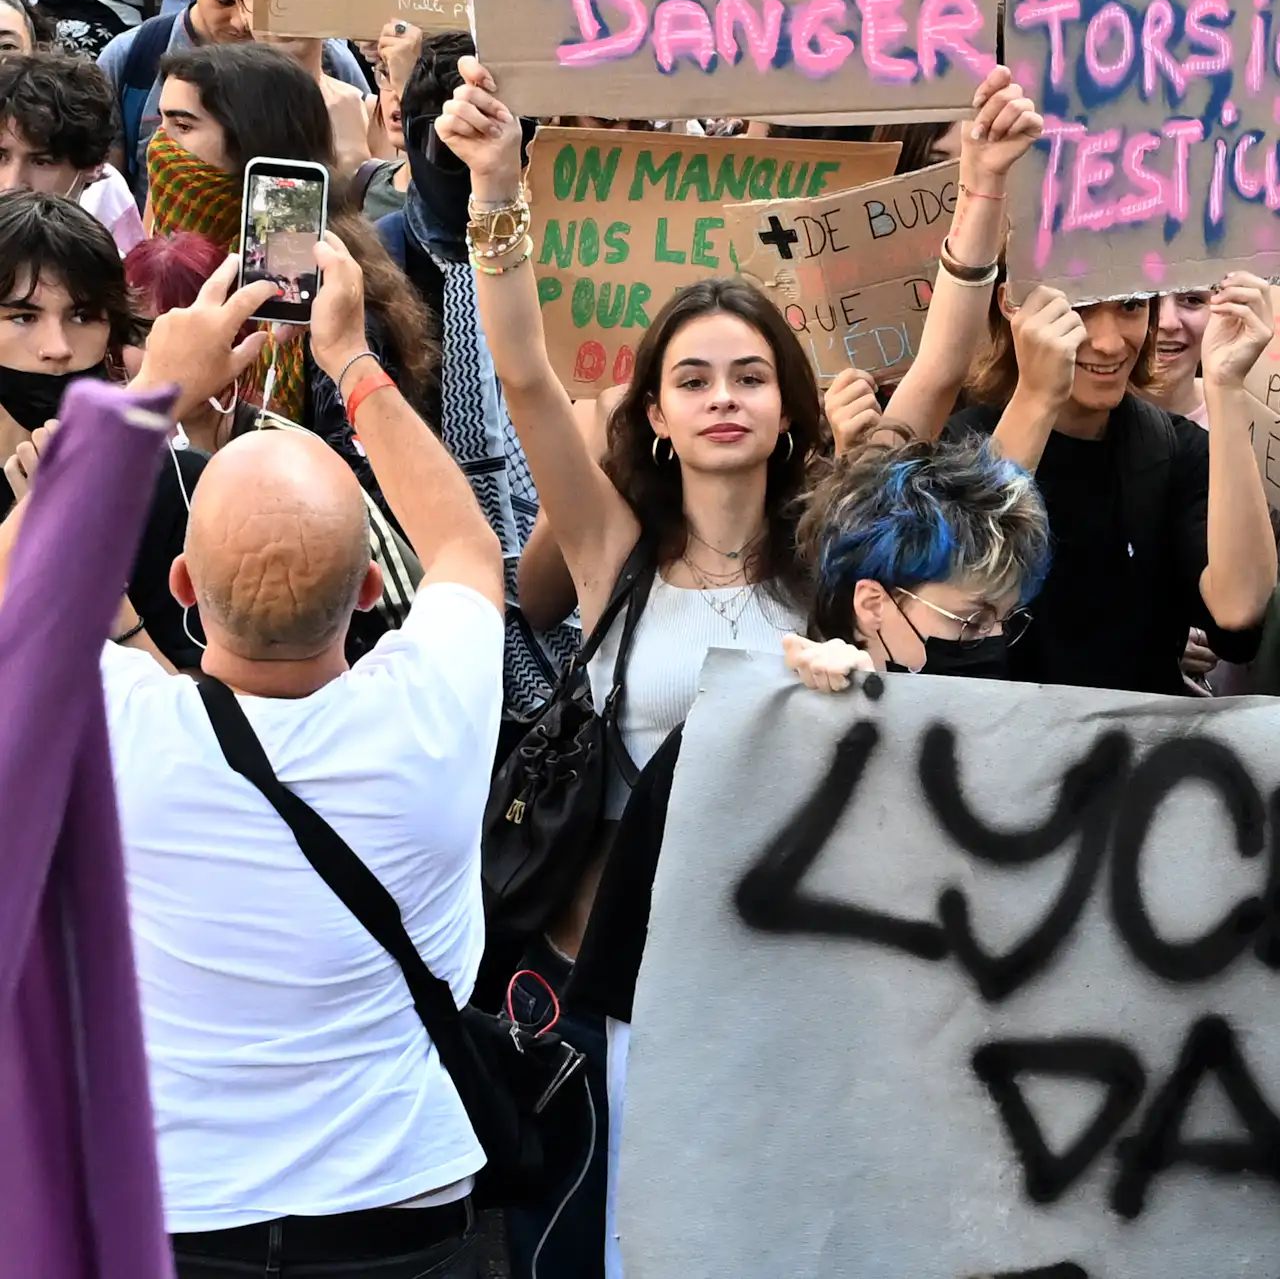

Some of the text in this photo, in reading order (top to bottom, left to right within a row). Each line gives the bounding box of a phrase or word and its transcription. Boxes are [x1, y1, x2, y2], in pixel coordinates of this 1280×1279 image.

[552, 142, 841, 203] ON MANQUE
[537, 214, 632, 269] NOS
[654, 216, 741, 271] LE
[801, 208, 850, 260] DE
[862, 181, 959, 240] BUDG
[537, 275, 653, 330] POUR
[784, 292, 869, 334] QUE
